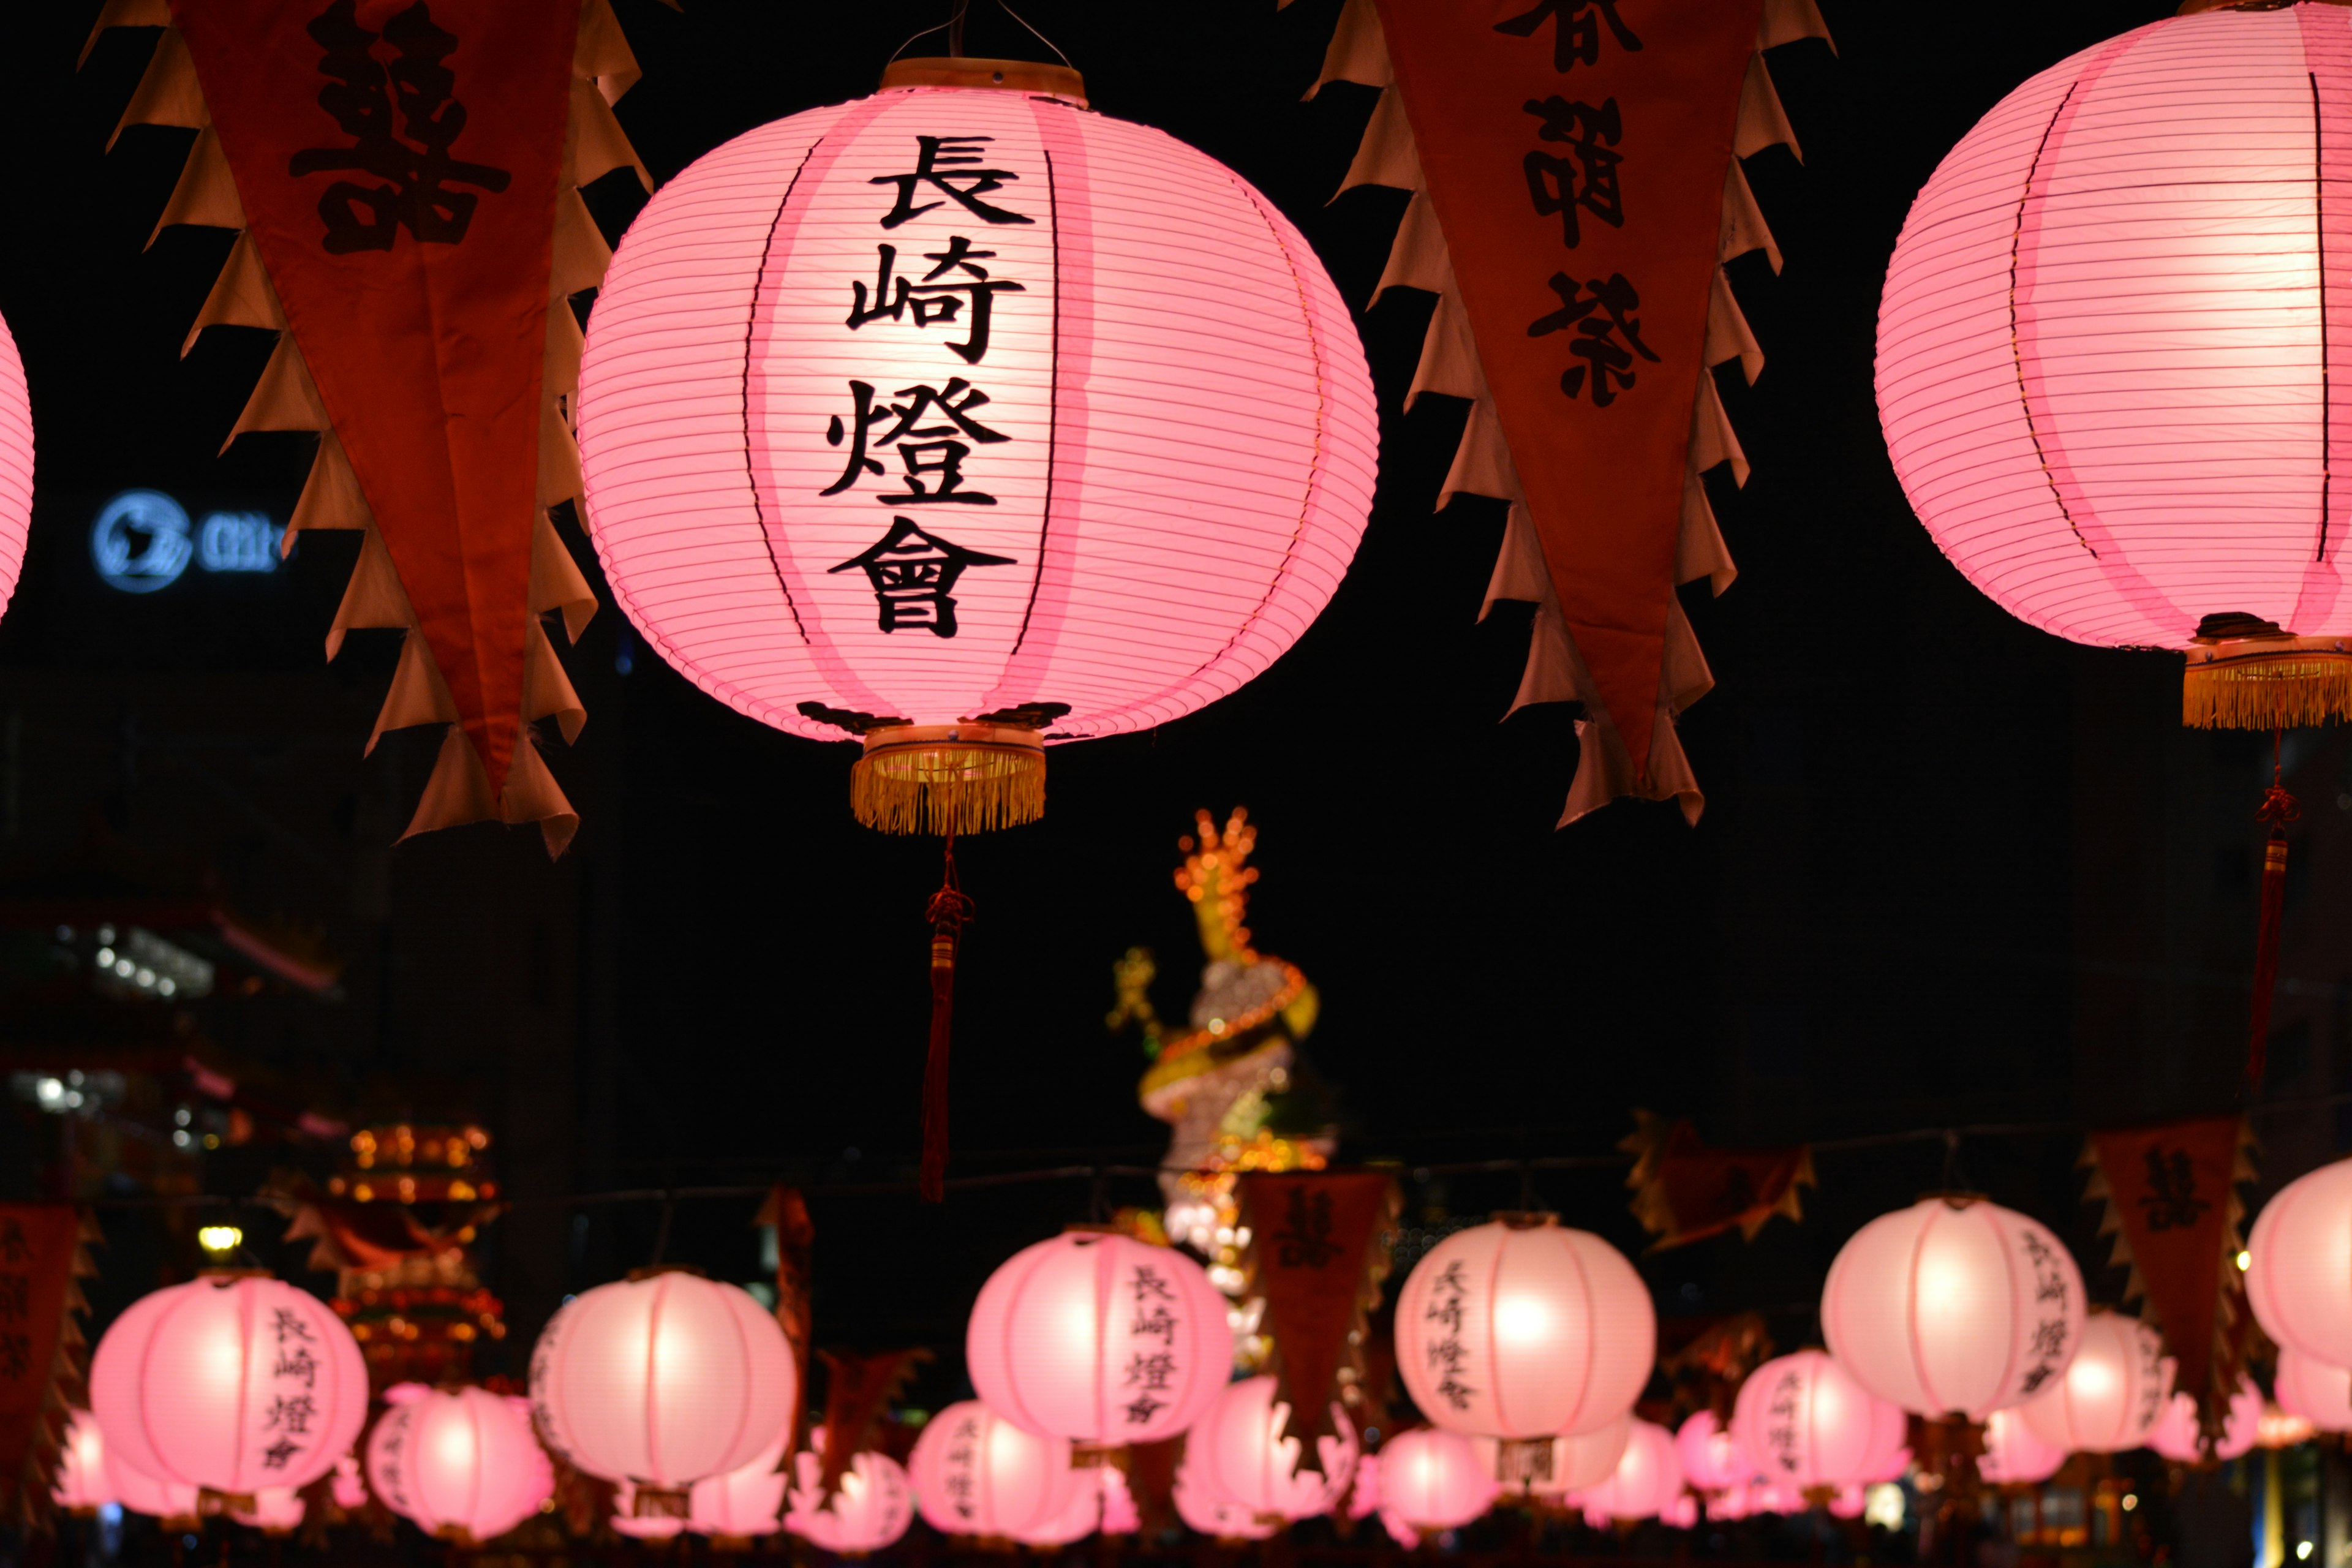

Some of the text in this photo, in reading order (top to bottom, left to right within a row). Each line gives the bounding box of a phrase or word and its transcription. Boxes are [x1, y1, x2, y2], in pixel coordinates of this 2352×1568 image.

[818, 135, 1036, 639] 長崎燈會
[265, 1306, 317, 1470] 長崎燈會
[1122, 1264, 1178, 1425] 長崎燈會
